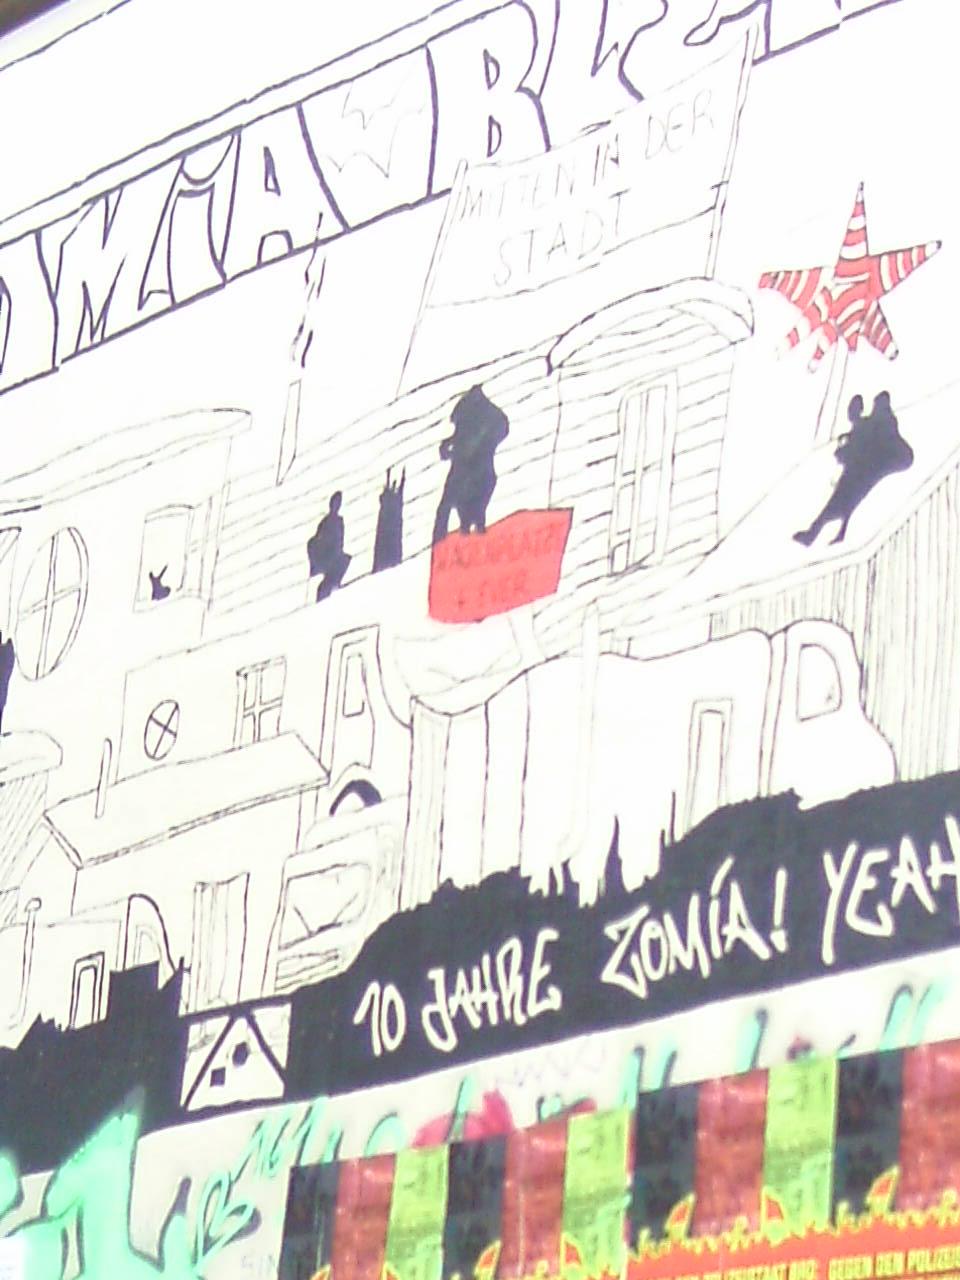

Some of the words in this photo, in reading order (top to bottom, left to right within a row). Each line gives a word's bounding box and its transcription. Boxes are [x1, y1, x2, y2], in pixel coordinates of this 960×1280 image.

[645, 88, 715, 161] DER
[493, 186, 632, 288] STADT
[353, 980, 407, 1057] 10
[421, 928, 562, 1054] JAHRE
